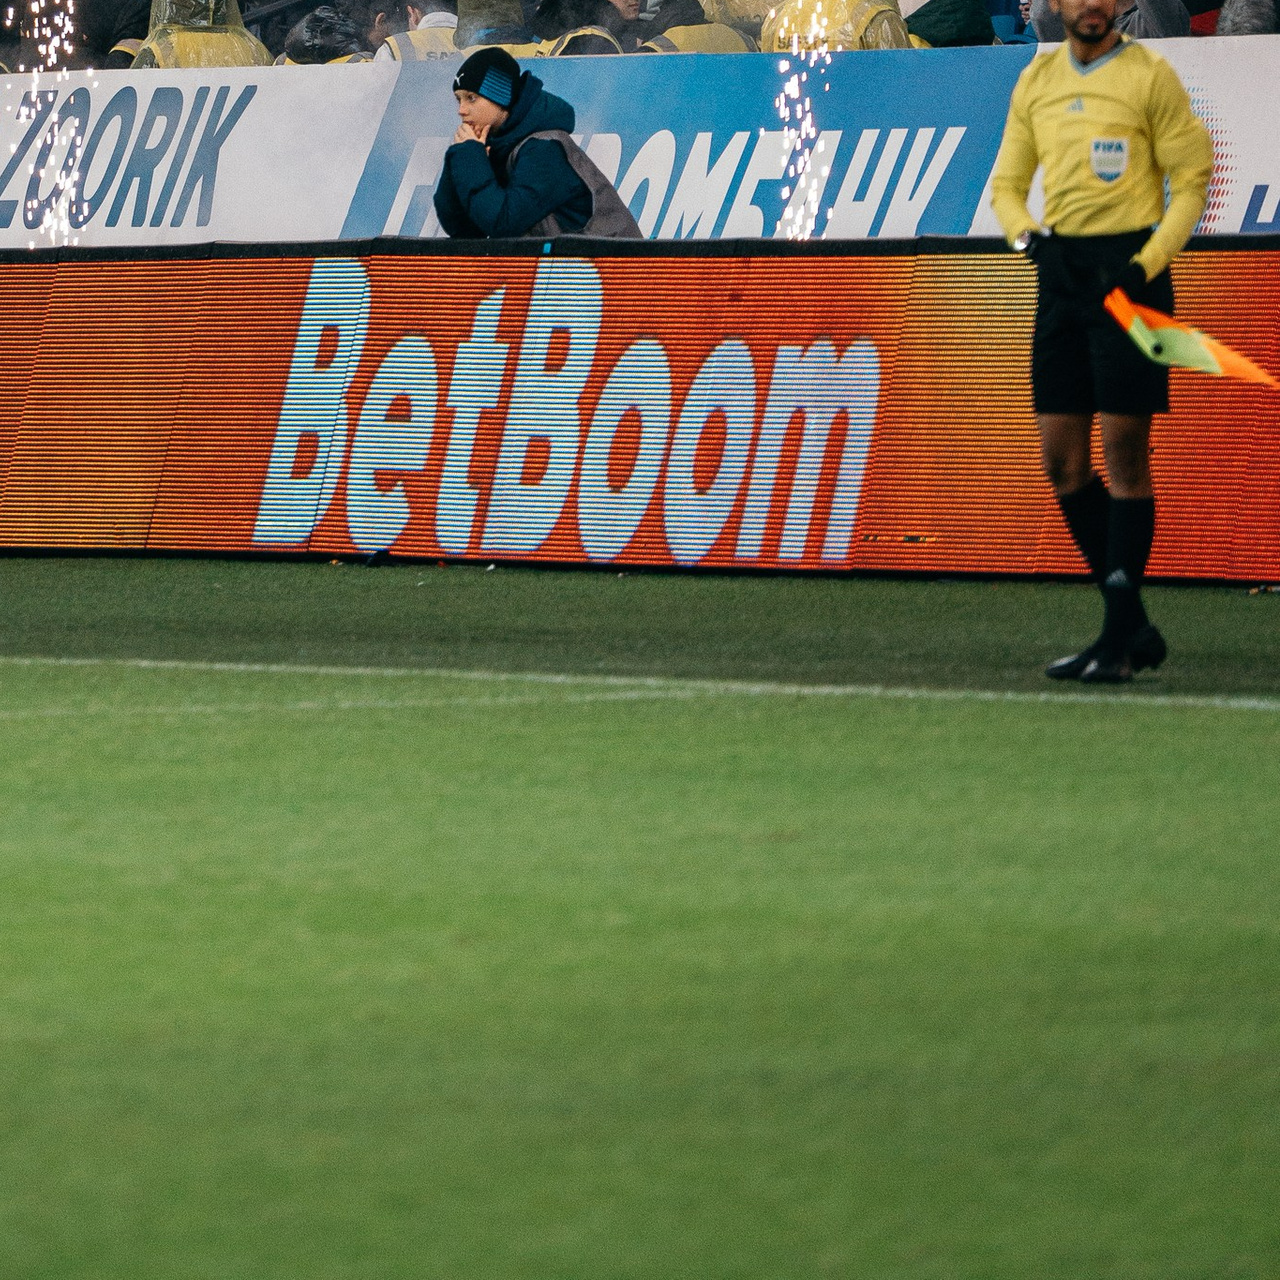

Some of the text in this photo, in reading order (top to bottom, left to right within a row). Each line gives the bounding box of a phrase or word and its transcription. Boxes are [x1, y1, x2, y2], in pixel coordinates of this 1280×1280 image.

[384, 126, 967, 240] ГОМБАНК
[1094, 141, 1123, 153] FIFA
[252, 257, 881, 566] BetBoom
